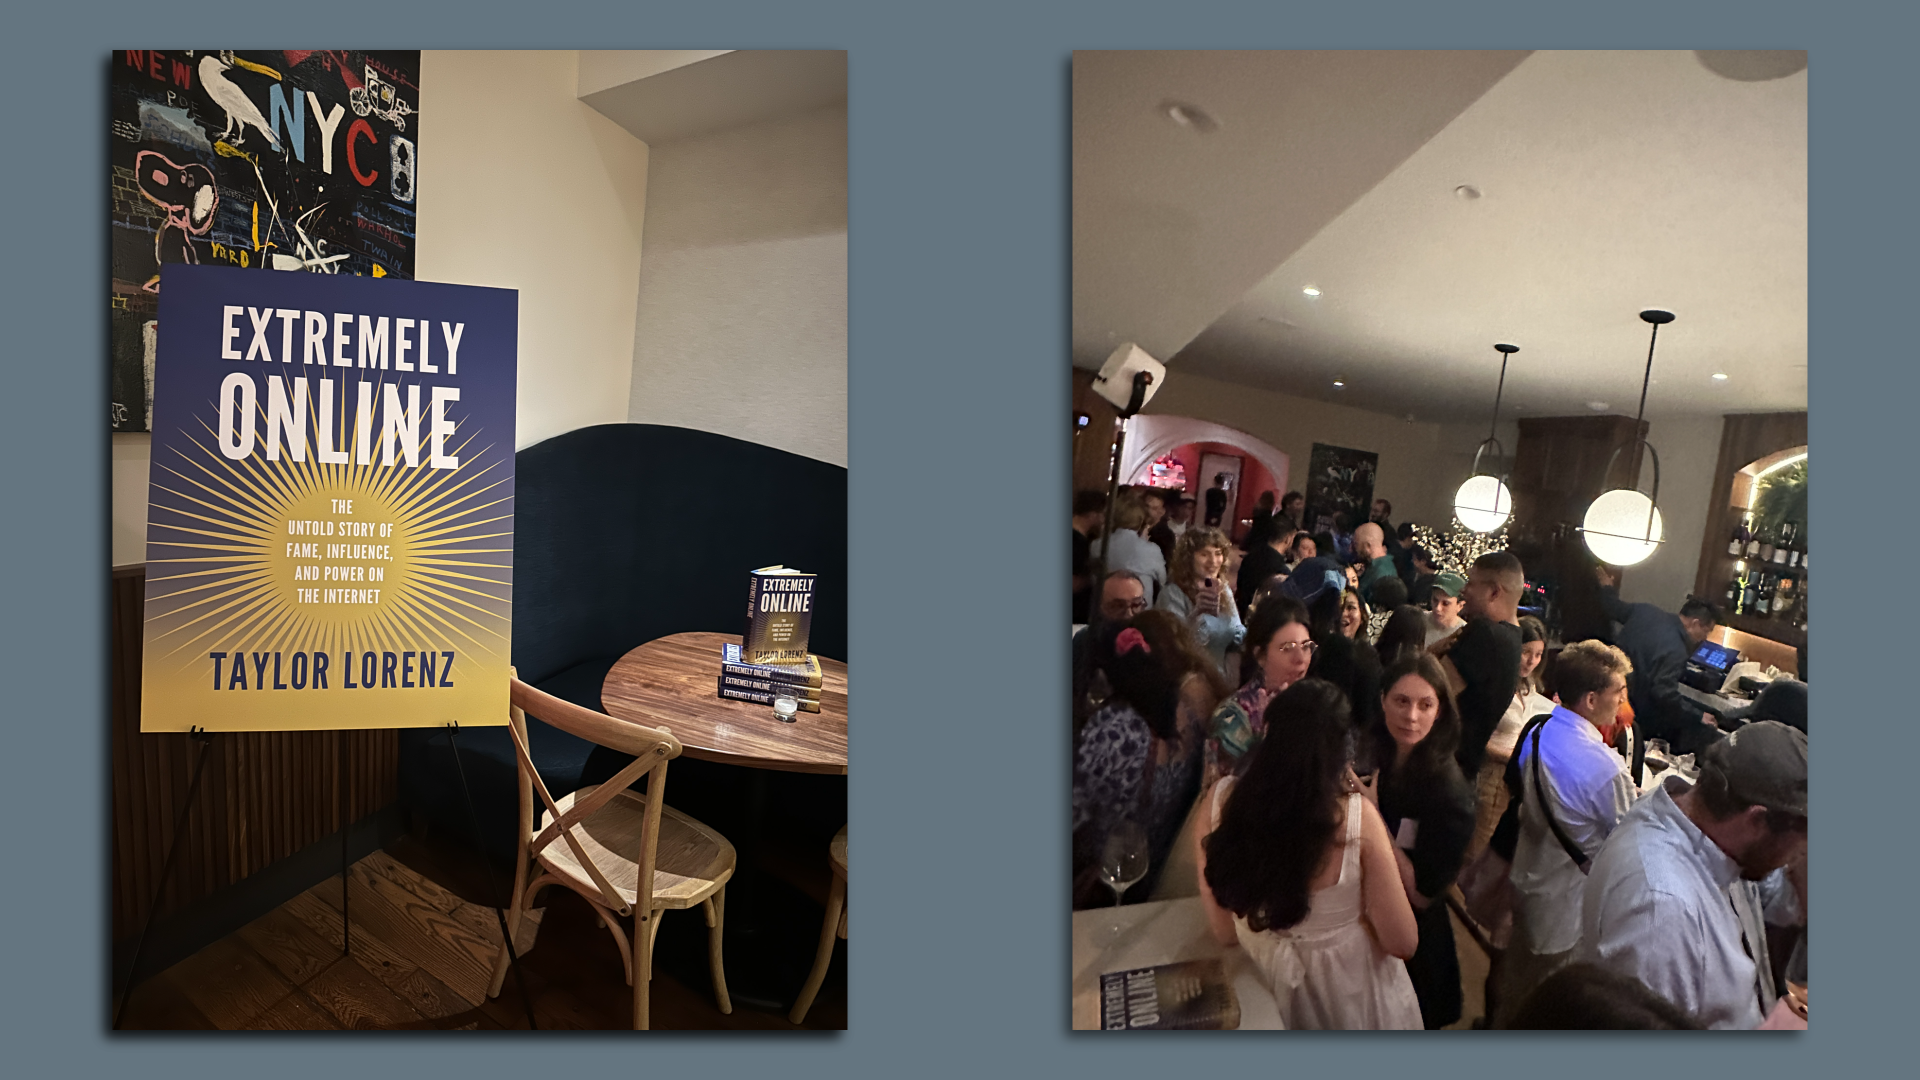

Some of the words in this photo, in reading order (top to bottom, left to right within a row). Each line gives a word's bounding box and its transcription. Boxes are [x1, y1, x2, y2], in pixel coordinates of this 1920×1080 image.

[126, 50, 191, 90] NEW
[269, 83, 379, 187] NYC
[357, 217, 406, 248] WARHOL
[362, 239, 403, 270] TWAIN
[221, 305, 465, 375] EXTREMELY
[218, 372, 461, 470] ONLINE
[331, 499, 353, 515] THE
[287, 520, 335, 537] UNTOLD
[338, 521, 375, 538] STORY
[379, 522, 394, 538] OF
[286, 543, 323, 561] FAME,
[326, 544, 394, 563] INFLUENCE,
[295, 565, 320, 581] AND
[324, 566, 365, 582] POWER
[368, 566, 384, 582] ON
[763, 579, 813, 591] EXTREMELY
[297, 588, 320, 604] THE
[323, 588, 380, 604] INTERNET
[761, 593, 811, 612] ONLINE
[755, 650, 778, 659] TAYLOR
[780, 650, 803, 659] LORENZ
[209, 652, 329, 690] TAYLOR
[344, 651, 455, 689] LORENZ
[726, 664, 754, 676] EXTREMELY
[753, 668, 772, 679] ONLINE
[725, 676, 752, 688] EXTREMELY
[752, 680, 770, 691] ONLINE
[723, 689, 751, 700] EXTREMELY
[751, 692, 769, 703] ONLINE
[1127, 969, 1160, 1027] ONLINE
